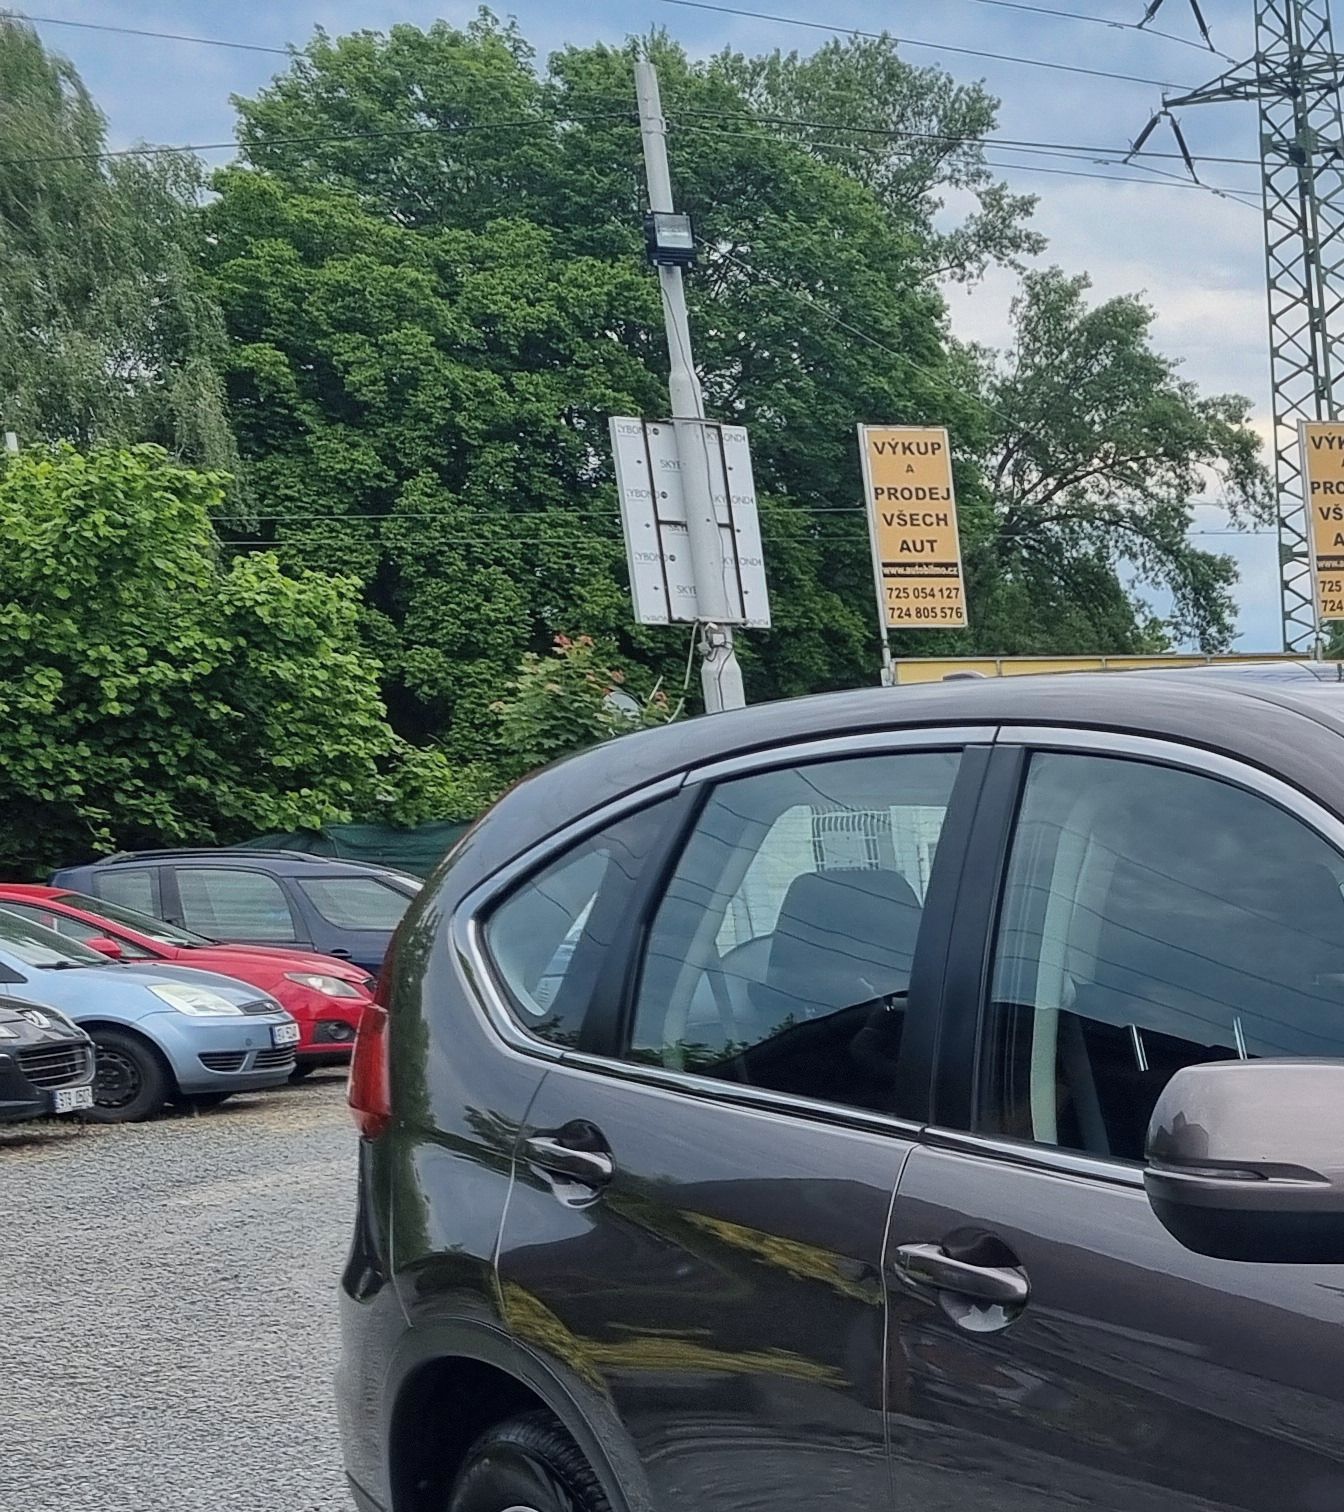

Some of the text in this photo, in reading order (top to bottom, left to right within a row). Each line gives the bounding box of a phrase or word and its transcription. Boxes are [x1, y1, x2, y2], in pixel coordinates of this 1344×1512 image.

[873, 437, 942, 456] VÝKUP
[905, 464, 915, 474] A
[874, 487, 951, 501] PRODEJ
[882, 510, 948, 527] VŠECH
[899, 540, 938, 553] AUT
[1320, 580, 1342, 592] 725
[886, 587, 960, 599] 725 054 127
[888, 606, 963, 619] 724 805 576
[1321, 600, 1344, 612] 724
